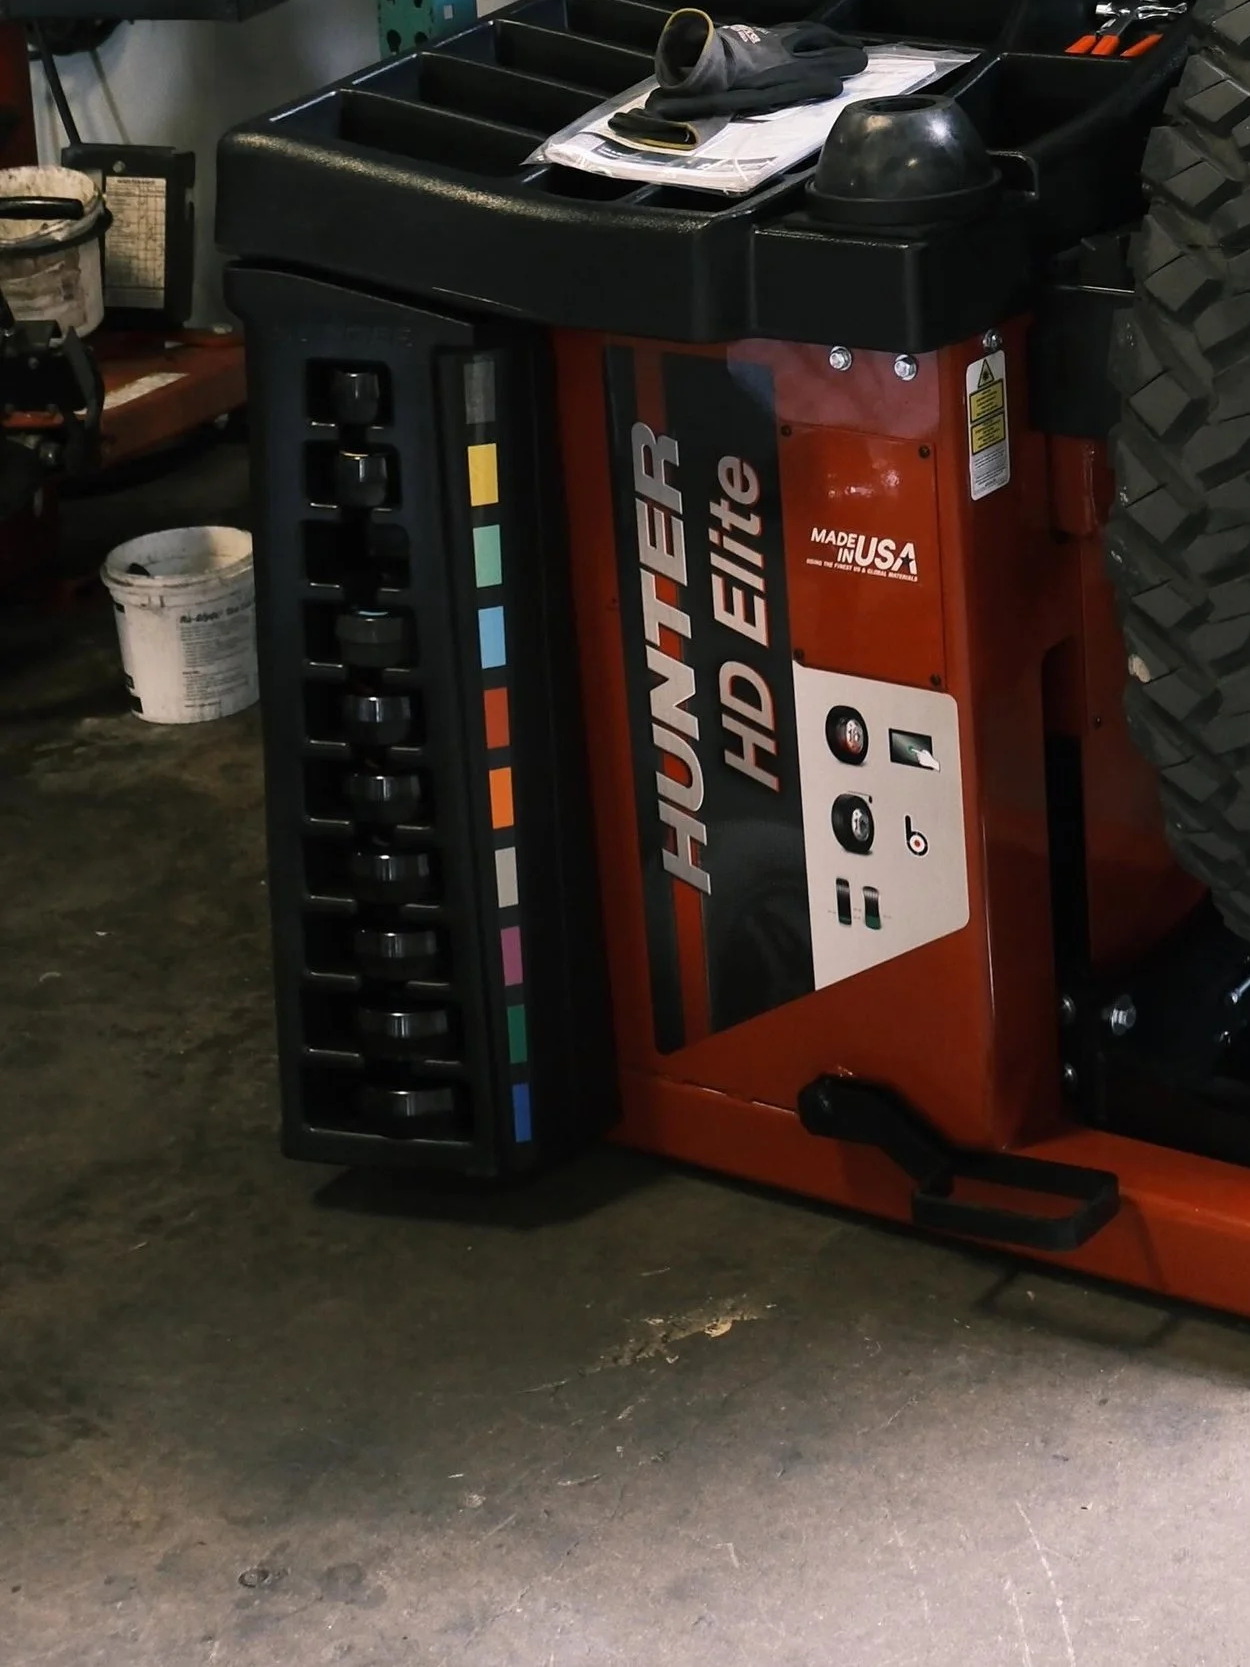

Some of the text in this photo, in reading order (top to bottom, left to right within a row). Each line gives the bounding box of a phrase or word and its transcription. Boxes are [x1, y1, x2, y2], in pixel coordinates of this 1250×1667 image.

[811, 527, 857, 548] MADE
[834, 563, 853, 571] FINEST
[837, 548, 855, 564] IN
[854, 534, 918, 575] USA
[708, 455, 780, 792] HD Elite
[631, 422, 711, 895] HUNTER
